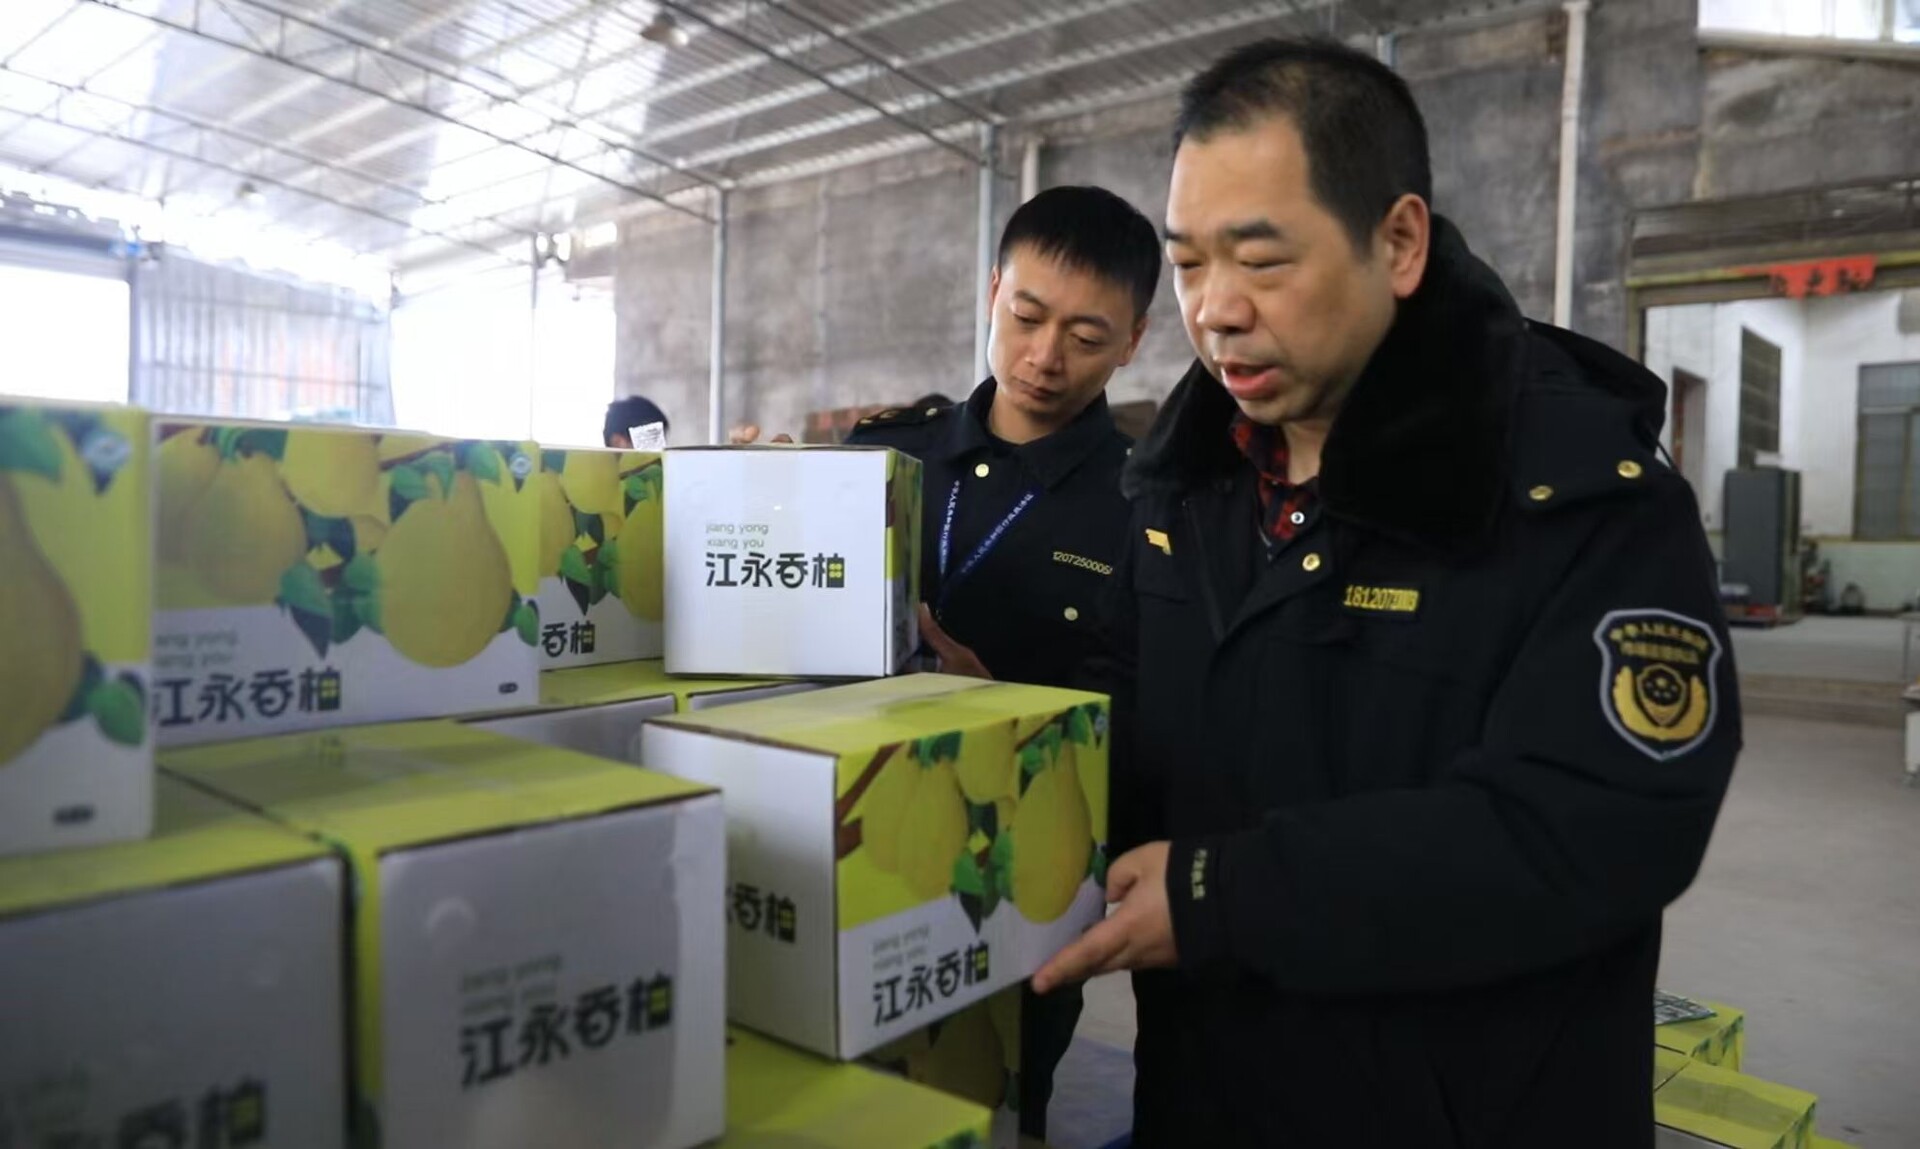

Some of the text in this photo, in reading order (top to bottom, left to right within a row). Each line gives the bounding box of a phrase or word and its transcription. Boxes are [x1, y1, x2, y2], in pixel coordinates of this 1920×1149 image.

[739, 523, 769, 536] yong
[742, 539, 764, 551] you
[705, 551, 845, 588] 江永香柚
[725, 882, 798, 944] 香柚
[873, 940, 990, 1027] 江永香柚
[460, 969, 673, 1091] 江永香柚
